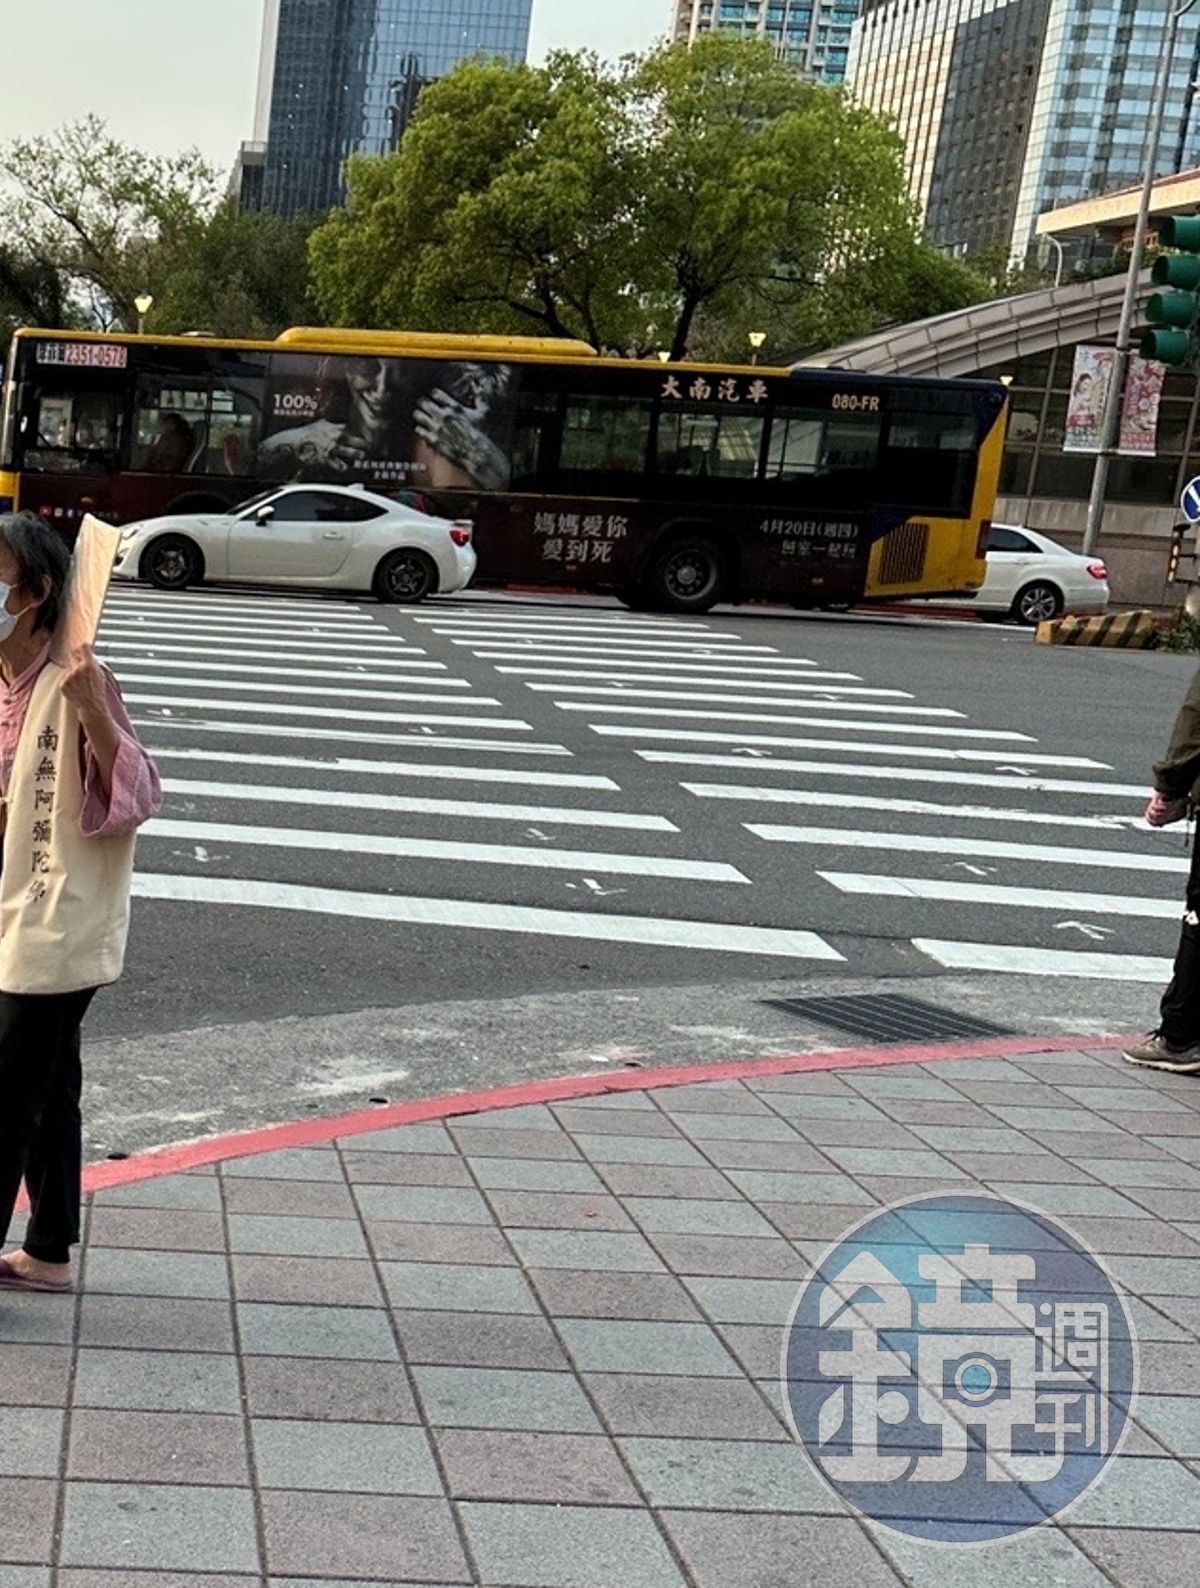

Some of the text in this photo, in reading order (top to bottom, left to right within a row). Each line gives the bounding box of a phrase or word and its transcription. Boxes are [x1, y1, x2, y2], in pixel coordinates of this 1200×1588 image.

[273, 393, 318, 410] 100%
[660, 375, 769, 403] 大南汽車
[831, 393, 880, 411] 080-FR
[533, 511, 628, 538] 媽媽愛你
[542, 538, 614, 562] 愛到死
[28, 725, 59, 902] 南無阿彌陀佛
